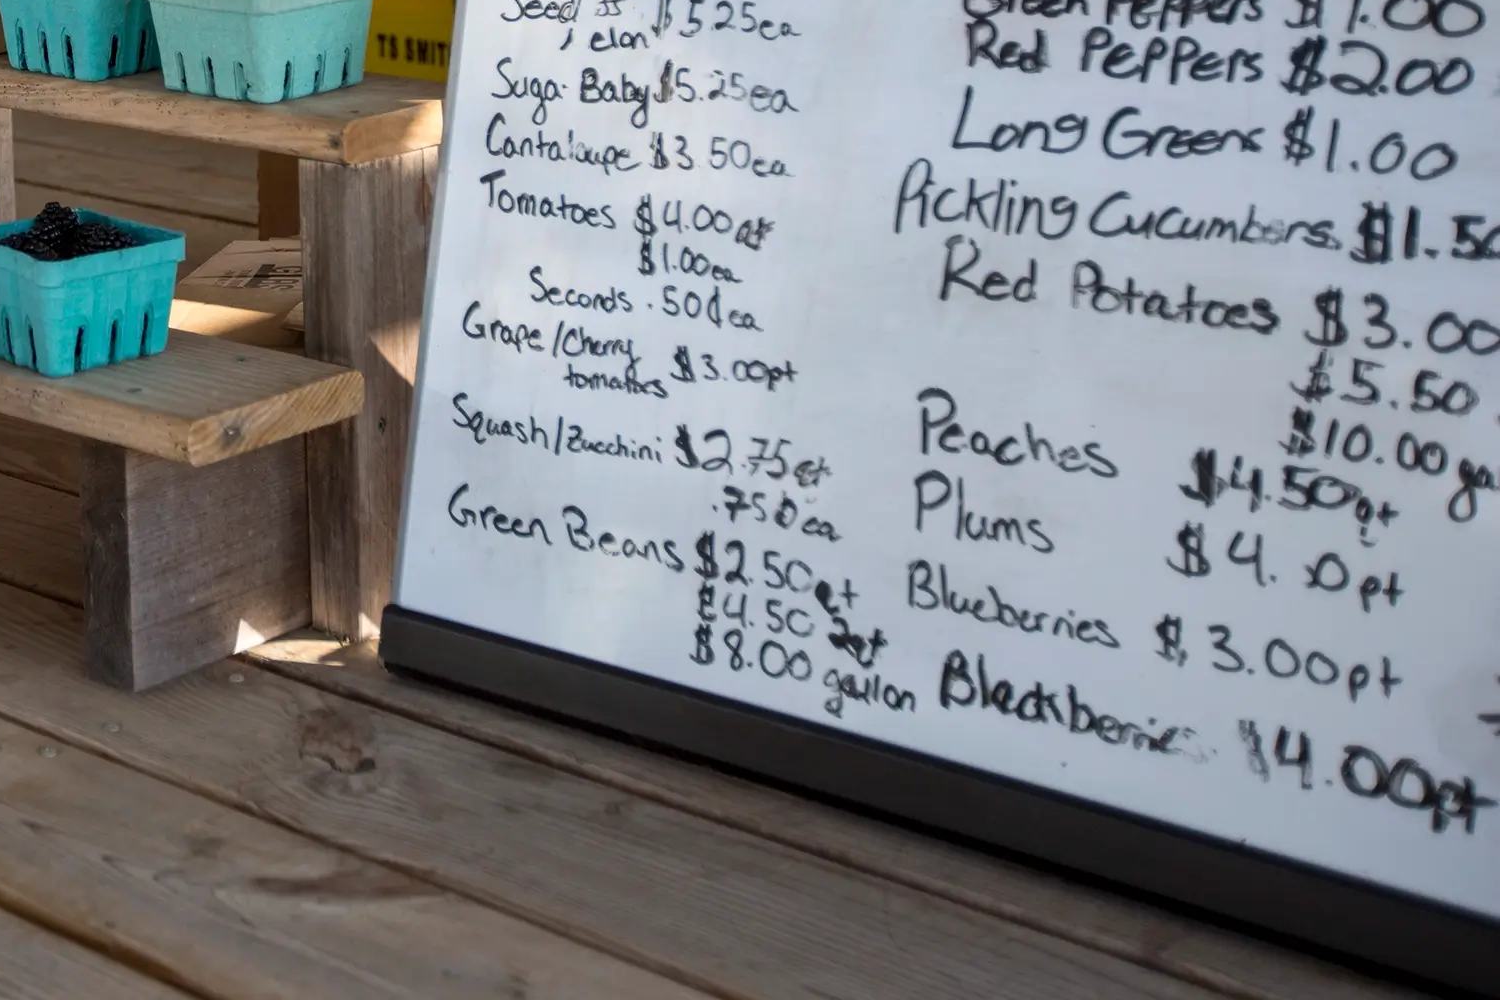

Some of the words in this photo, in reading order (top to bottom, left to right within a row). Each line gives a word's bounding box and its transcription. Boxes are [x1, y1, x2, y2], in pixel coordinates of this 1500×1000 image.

[405, 36, 450, 68] SMIT
[491, 57, 568, 126] Suga
[580, 66, 652, 128] Baby
[967, 18, 1049, 74] Red
[1281, 34, 1476, 96] $2.00
[951, 85, 1089, 154] Long
[1283, 104, 1460, 181] $1.00
[480, 169, 617, 230] Tomatoes
[894, 157, 1080, 240] Pickling
[529, 265, 633, 313] Seconds
[940, 234, 1038, 301] Red
[1072, 258, 1282, 335] Potatoes
[915, 386, 1120, 478] Peaches
[449, 483, 553, 546] Green
[561, 505, 686, 573] Beans
[913, 469, 1055, 553] Plums
[1358, 571, 1405, 613] pt
[907, 559, 1121, 649] Blueberries
[939, 648, 1218, 762] Blackberrie
